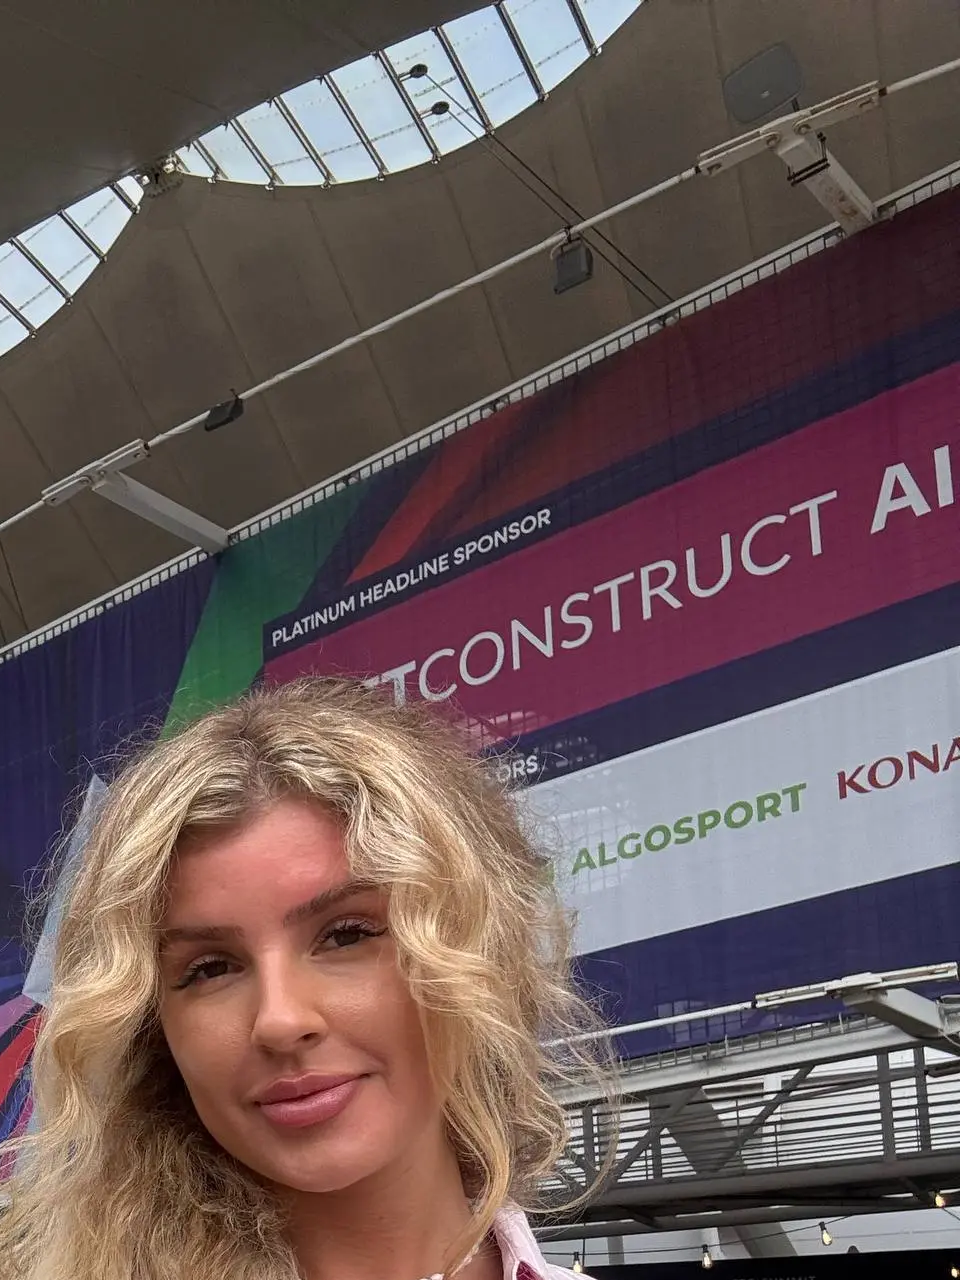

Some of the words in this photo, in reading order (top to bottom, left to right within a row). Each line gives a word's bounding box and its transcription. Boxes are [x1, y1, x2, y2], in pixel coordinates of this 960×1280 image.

[271, 596, 356, 647] PLATINUM
[359, 554, 450, 609] HEADLINE
[453, 508, 551, 571] SPONSOR
[362, 490, 837, 708] TCONSTRUCT
[870, 444, 954, 535] AI
[571, 783, 807, 875] ALGOSPORT
